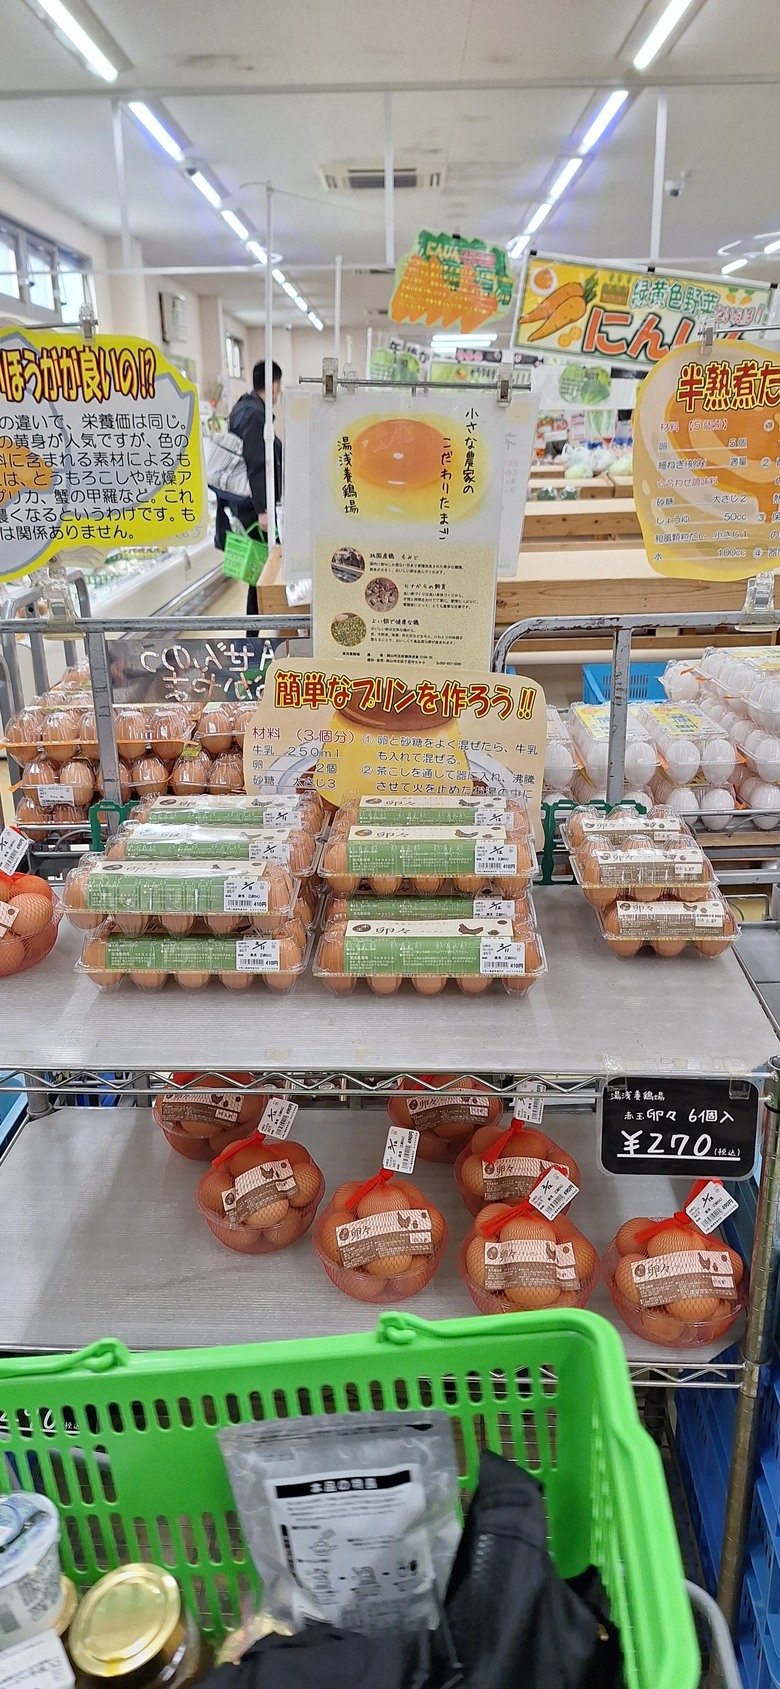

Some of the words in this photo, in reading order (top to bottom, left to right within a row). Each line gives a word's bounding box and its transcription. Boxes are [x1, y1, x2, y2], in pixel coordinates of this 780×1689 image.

[630, 278, 721, 318] 緑黄色野菜
[0, 414, 187, 430] の違いで、栄養価は同じ。
[660, 420, 679, 432] 材料
[0, 434, 188, 450] の黄身が人気ですが、色の
[659, 442, 668, 451] 卵
[462, 408, 479, 494] 小さな農家の
[338, 436, 358, 514] 湯浅養鶏場
[656, 498, 673, 506] 砂糖
[712, 494, 746, 504] 大さじ2
[656, 515, 690, 525] しょうゆ
[724, 512, 746, 521] 50cc
[1, 526, 135, 540] は関係ありません。
[654, 552, 662, 560] 水
[719, 548, 746, 557] 100cc
[274, 670, 536, 720] 簡単なプリンを作ろう!!
[252, 726, 280, 740] 材料
[252, 744, 274, 756] 牛乳
[378, 736, 538, 755] 卵と砂糖をよく混ぜたら、牛乳
[378, 750, 462, 766] も入れて混ぜる。
[252, 760, 263, 769] 卵
[316, 763, 336, 774] 2個
[253, 775, 274, 785] 砂糖
[293, 777, 336, 788] 大さじ3
[377, 766, 535, 785] 茶こしを通して器に入れ、沸騰
[609, 1090, 666, 1101] 湯浅養鶏場
[688, 1109, 734, 1124] 6個入
[621, 1130, 712, 1156] ¥270
[714, 1148, 740, 1156] (税込)
[722, 1199, 734, 1210] 490円
